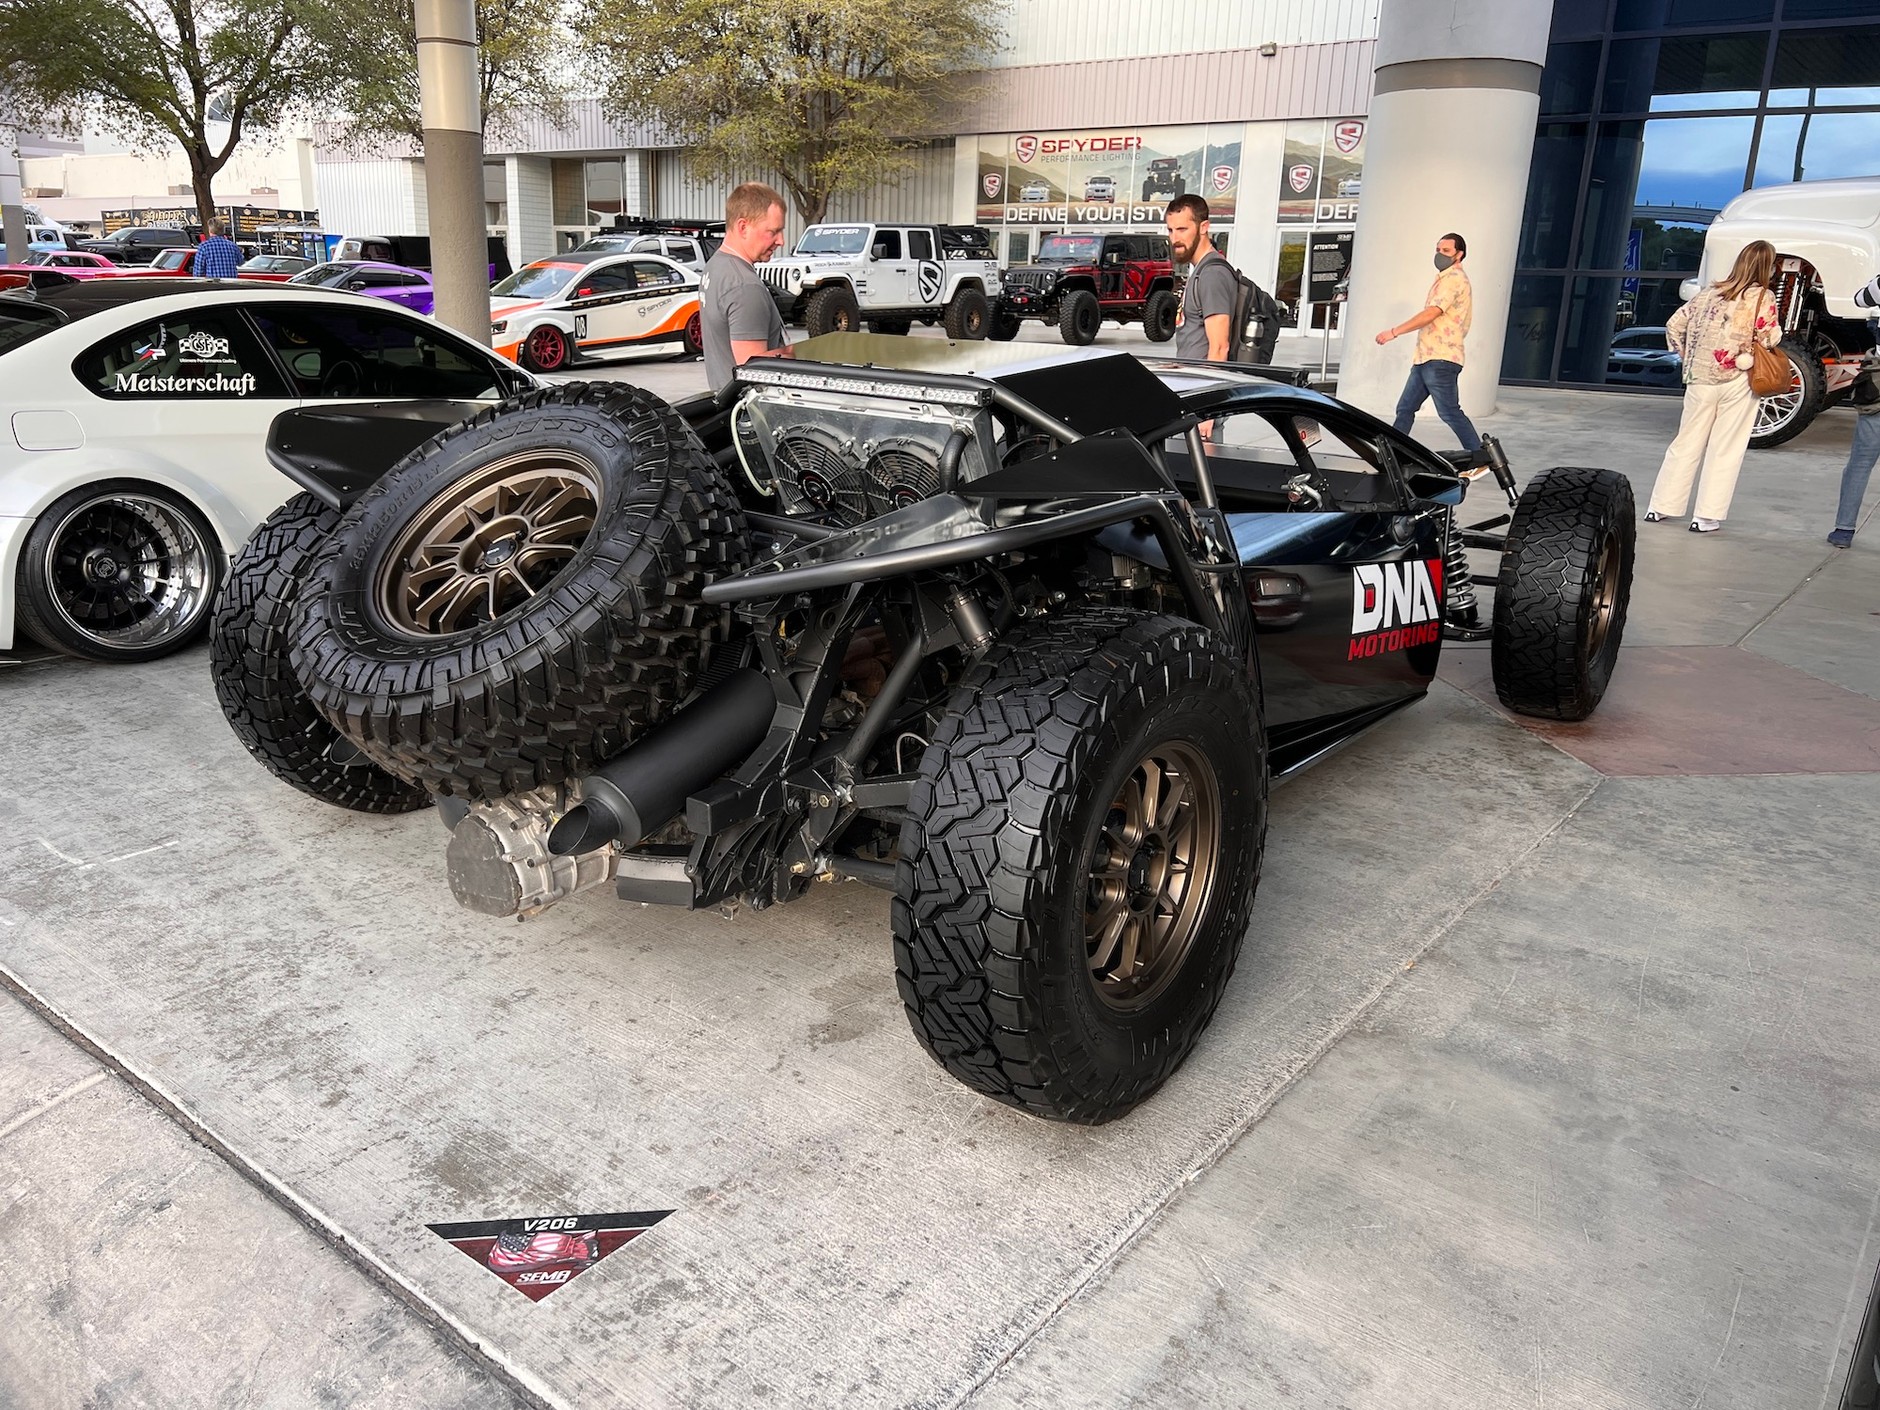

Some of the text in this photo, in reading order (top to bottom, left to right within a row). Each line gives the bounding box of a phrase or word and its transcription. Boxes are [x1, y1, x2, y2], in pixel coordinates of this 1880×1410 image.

[1041, 137, 1142, 153] SPYDER
[1041, 153, 1141, 163] PERFORMANCE LIGHTING
[1007, 206, 1166, 221] DEFINE YOUR STY
[1318, 204, 1359, 220] DEF
[646, 298, 672, 312] SPYDER
[575, 316, 587, 338] 08
[192, 339, 213, 353] CSF
[114, 373, 256, 396] Meisterschaft
[1351, 559, 1440, 635] DNA
[1348, 621, 1439, 661] MOTORING
[524, 1217, 578, 1232] V206
[517, 1270, 572, 1284] SEMA
